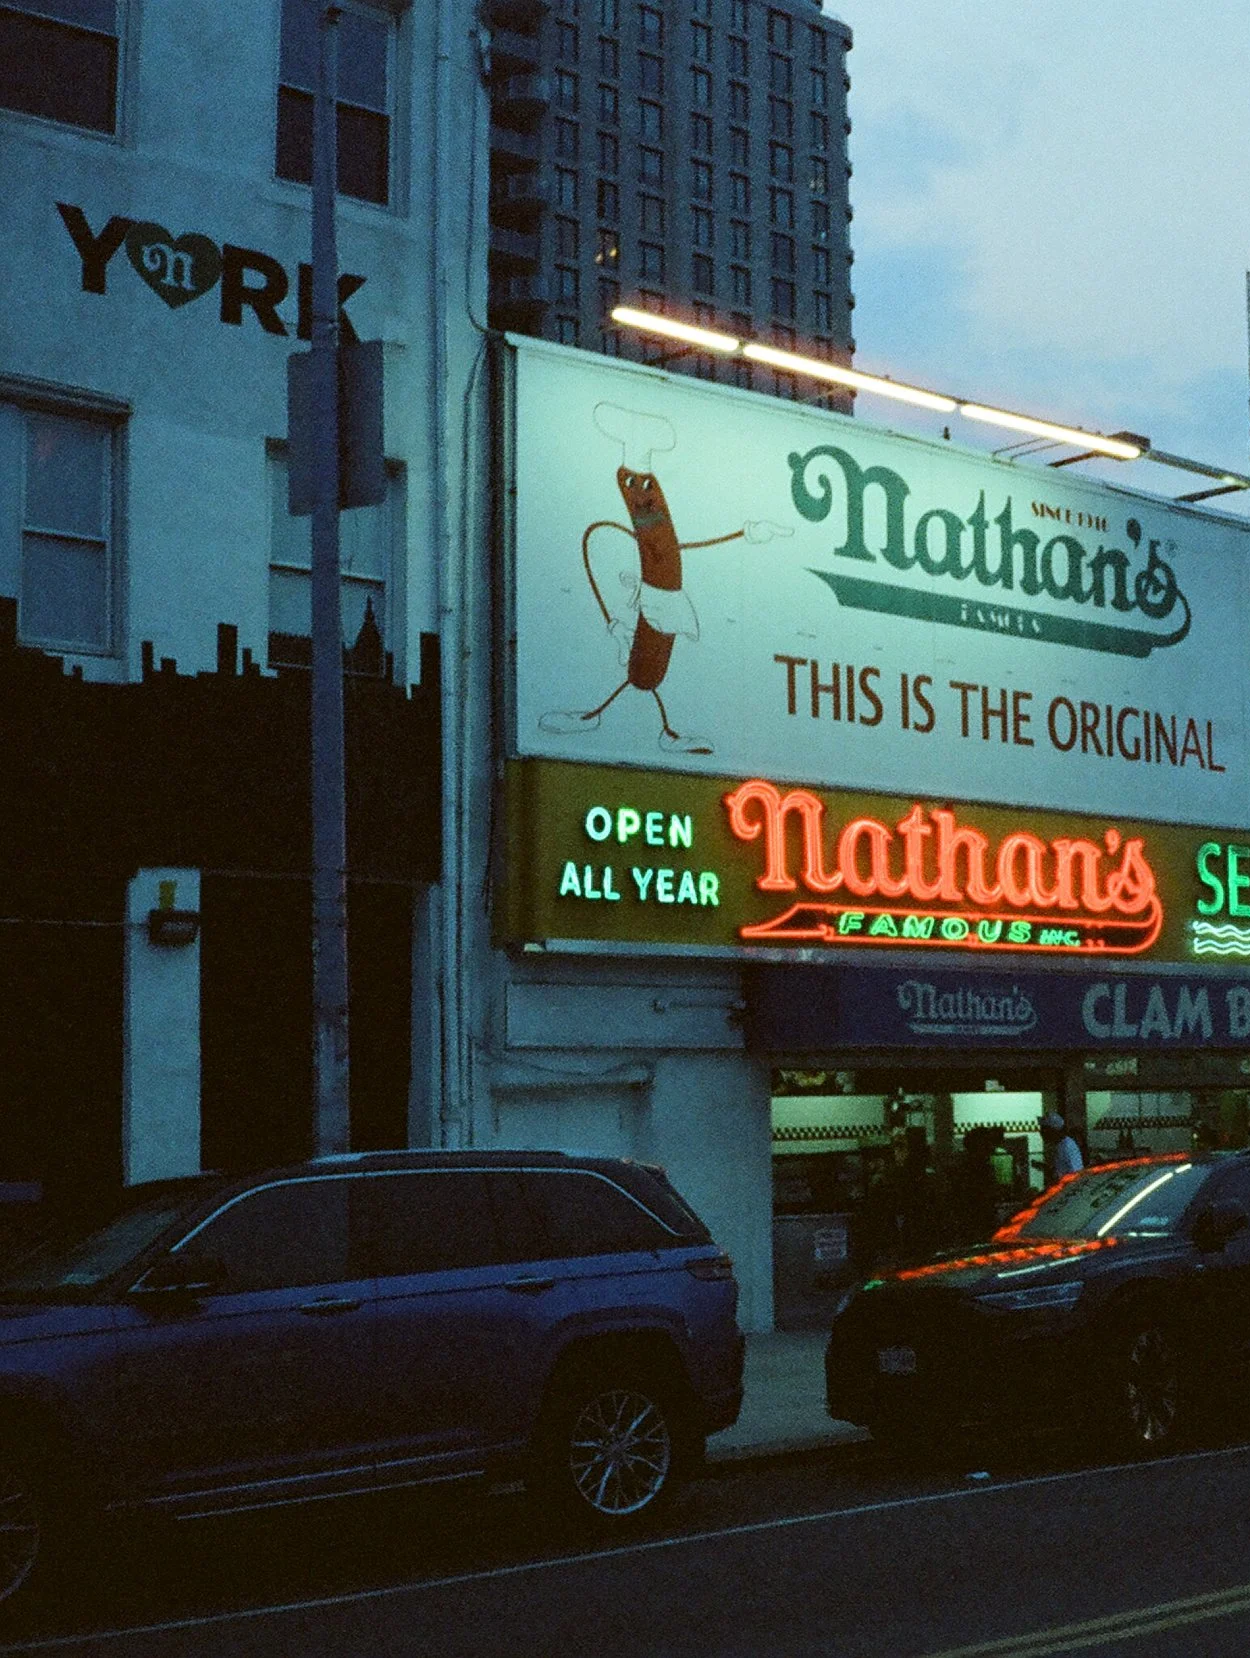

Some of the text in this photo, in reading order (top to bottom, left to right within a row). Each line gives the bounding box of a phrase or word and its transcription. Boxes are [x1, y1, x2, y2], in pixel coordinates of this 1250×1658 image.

[787, 444, 1179, 620] Nathan's
[773, 654, 1227, 773] THIS IS THE ORIGINAL
[585, 806, 694, 848] OPEN
[726, 779, 1157, 914] Nathan's
[559, 860, 720, 907] ALL YEAR
[838, 911, 1032, 945] FAMOUS
[897, 979, 1038, 1027] Nathan's
[1081, 983, 1215, 1039] CLAM
